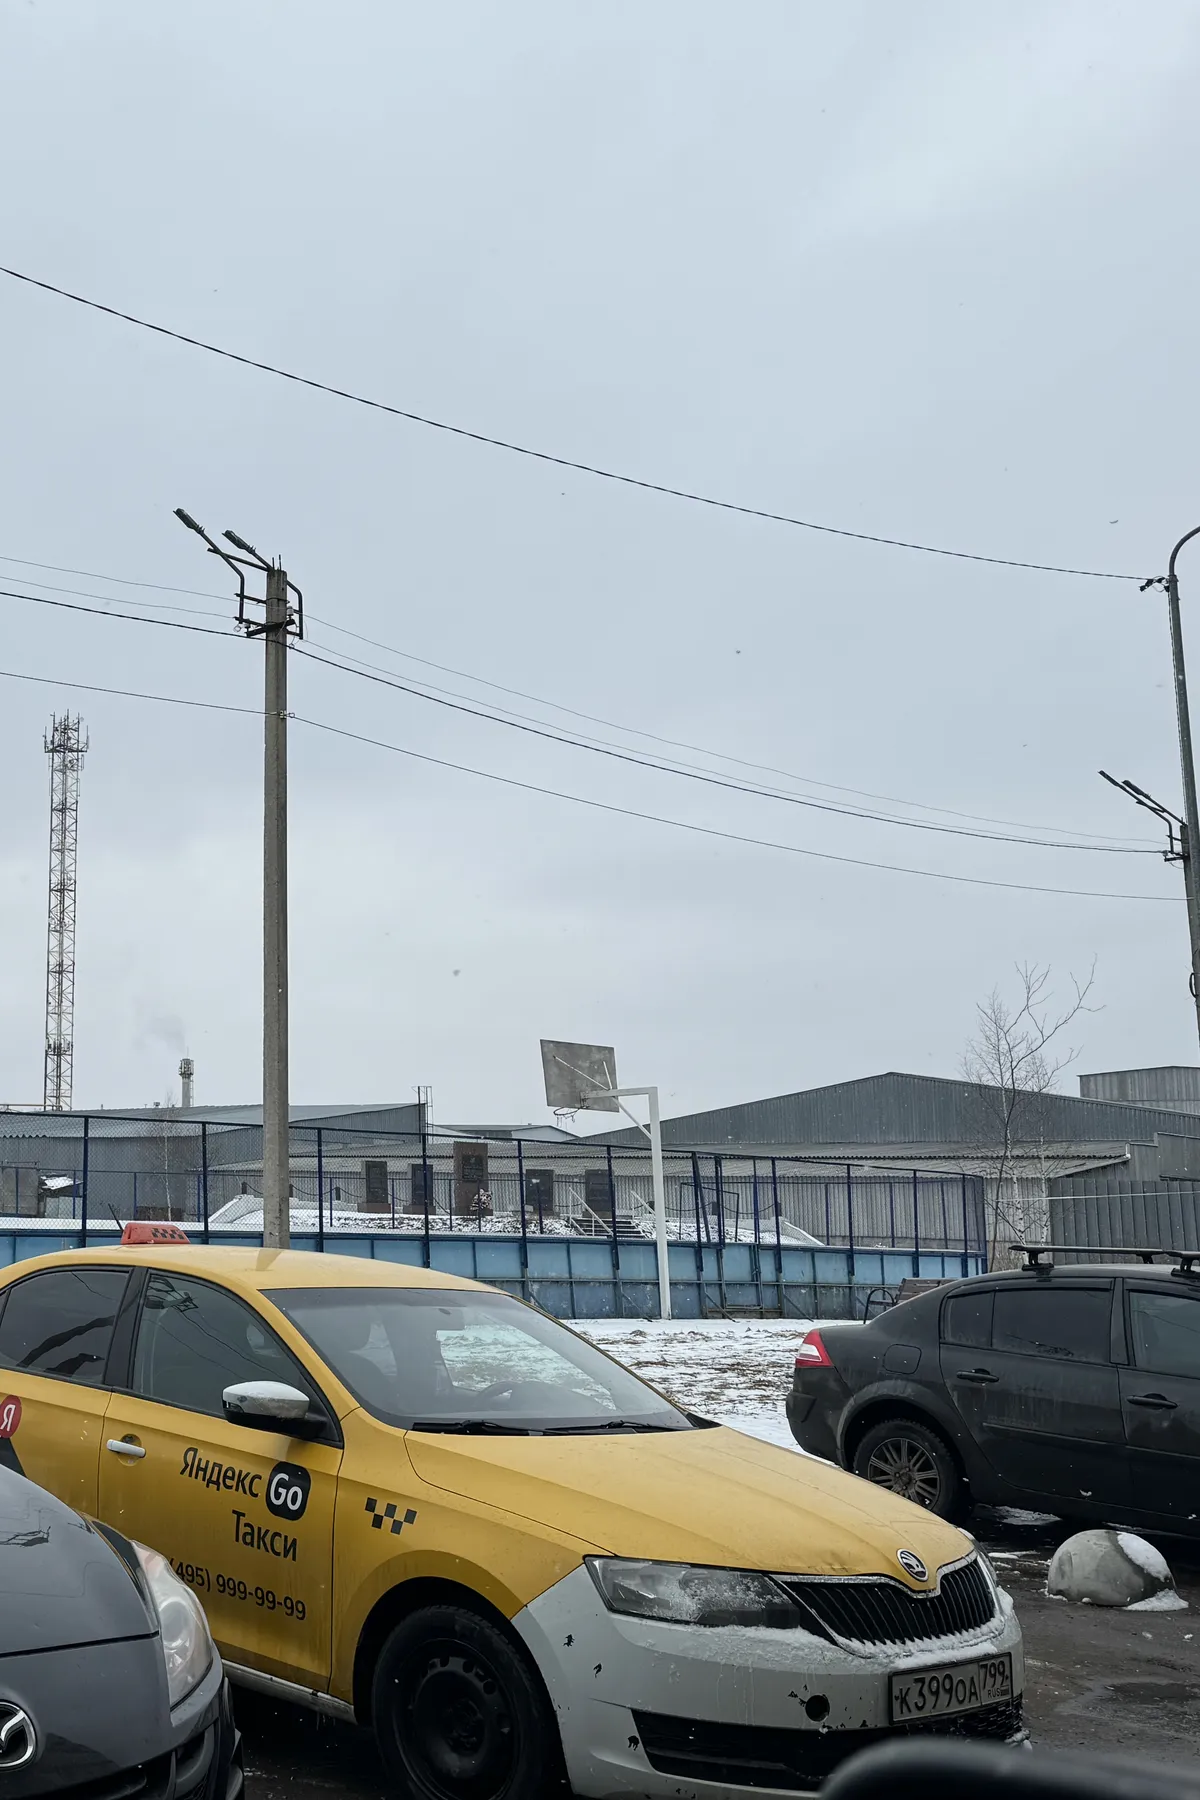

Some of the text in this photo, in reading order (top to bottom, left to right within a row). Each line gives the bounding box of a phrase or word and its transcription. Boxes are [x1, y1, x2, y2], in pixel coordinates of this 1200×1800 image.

[0, 1404, 16, 1432] Я
[179, 1446, 262, 1498] Яндекс
[269, 1472, 303, 1511] Go
[231, 1509, 298, 1562] Такси
[216, 1573, 307, 1621] 999-99-99
[979, 1660, 1006, 1691] 799
[987, 1689, 1000, 1699] RUS
